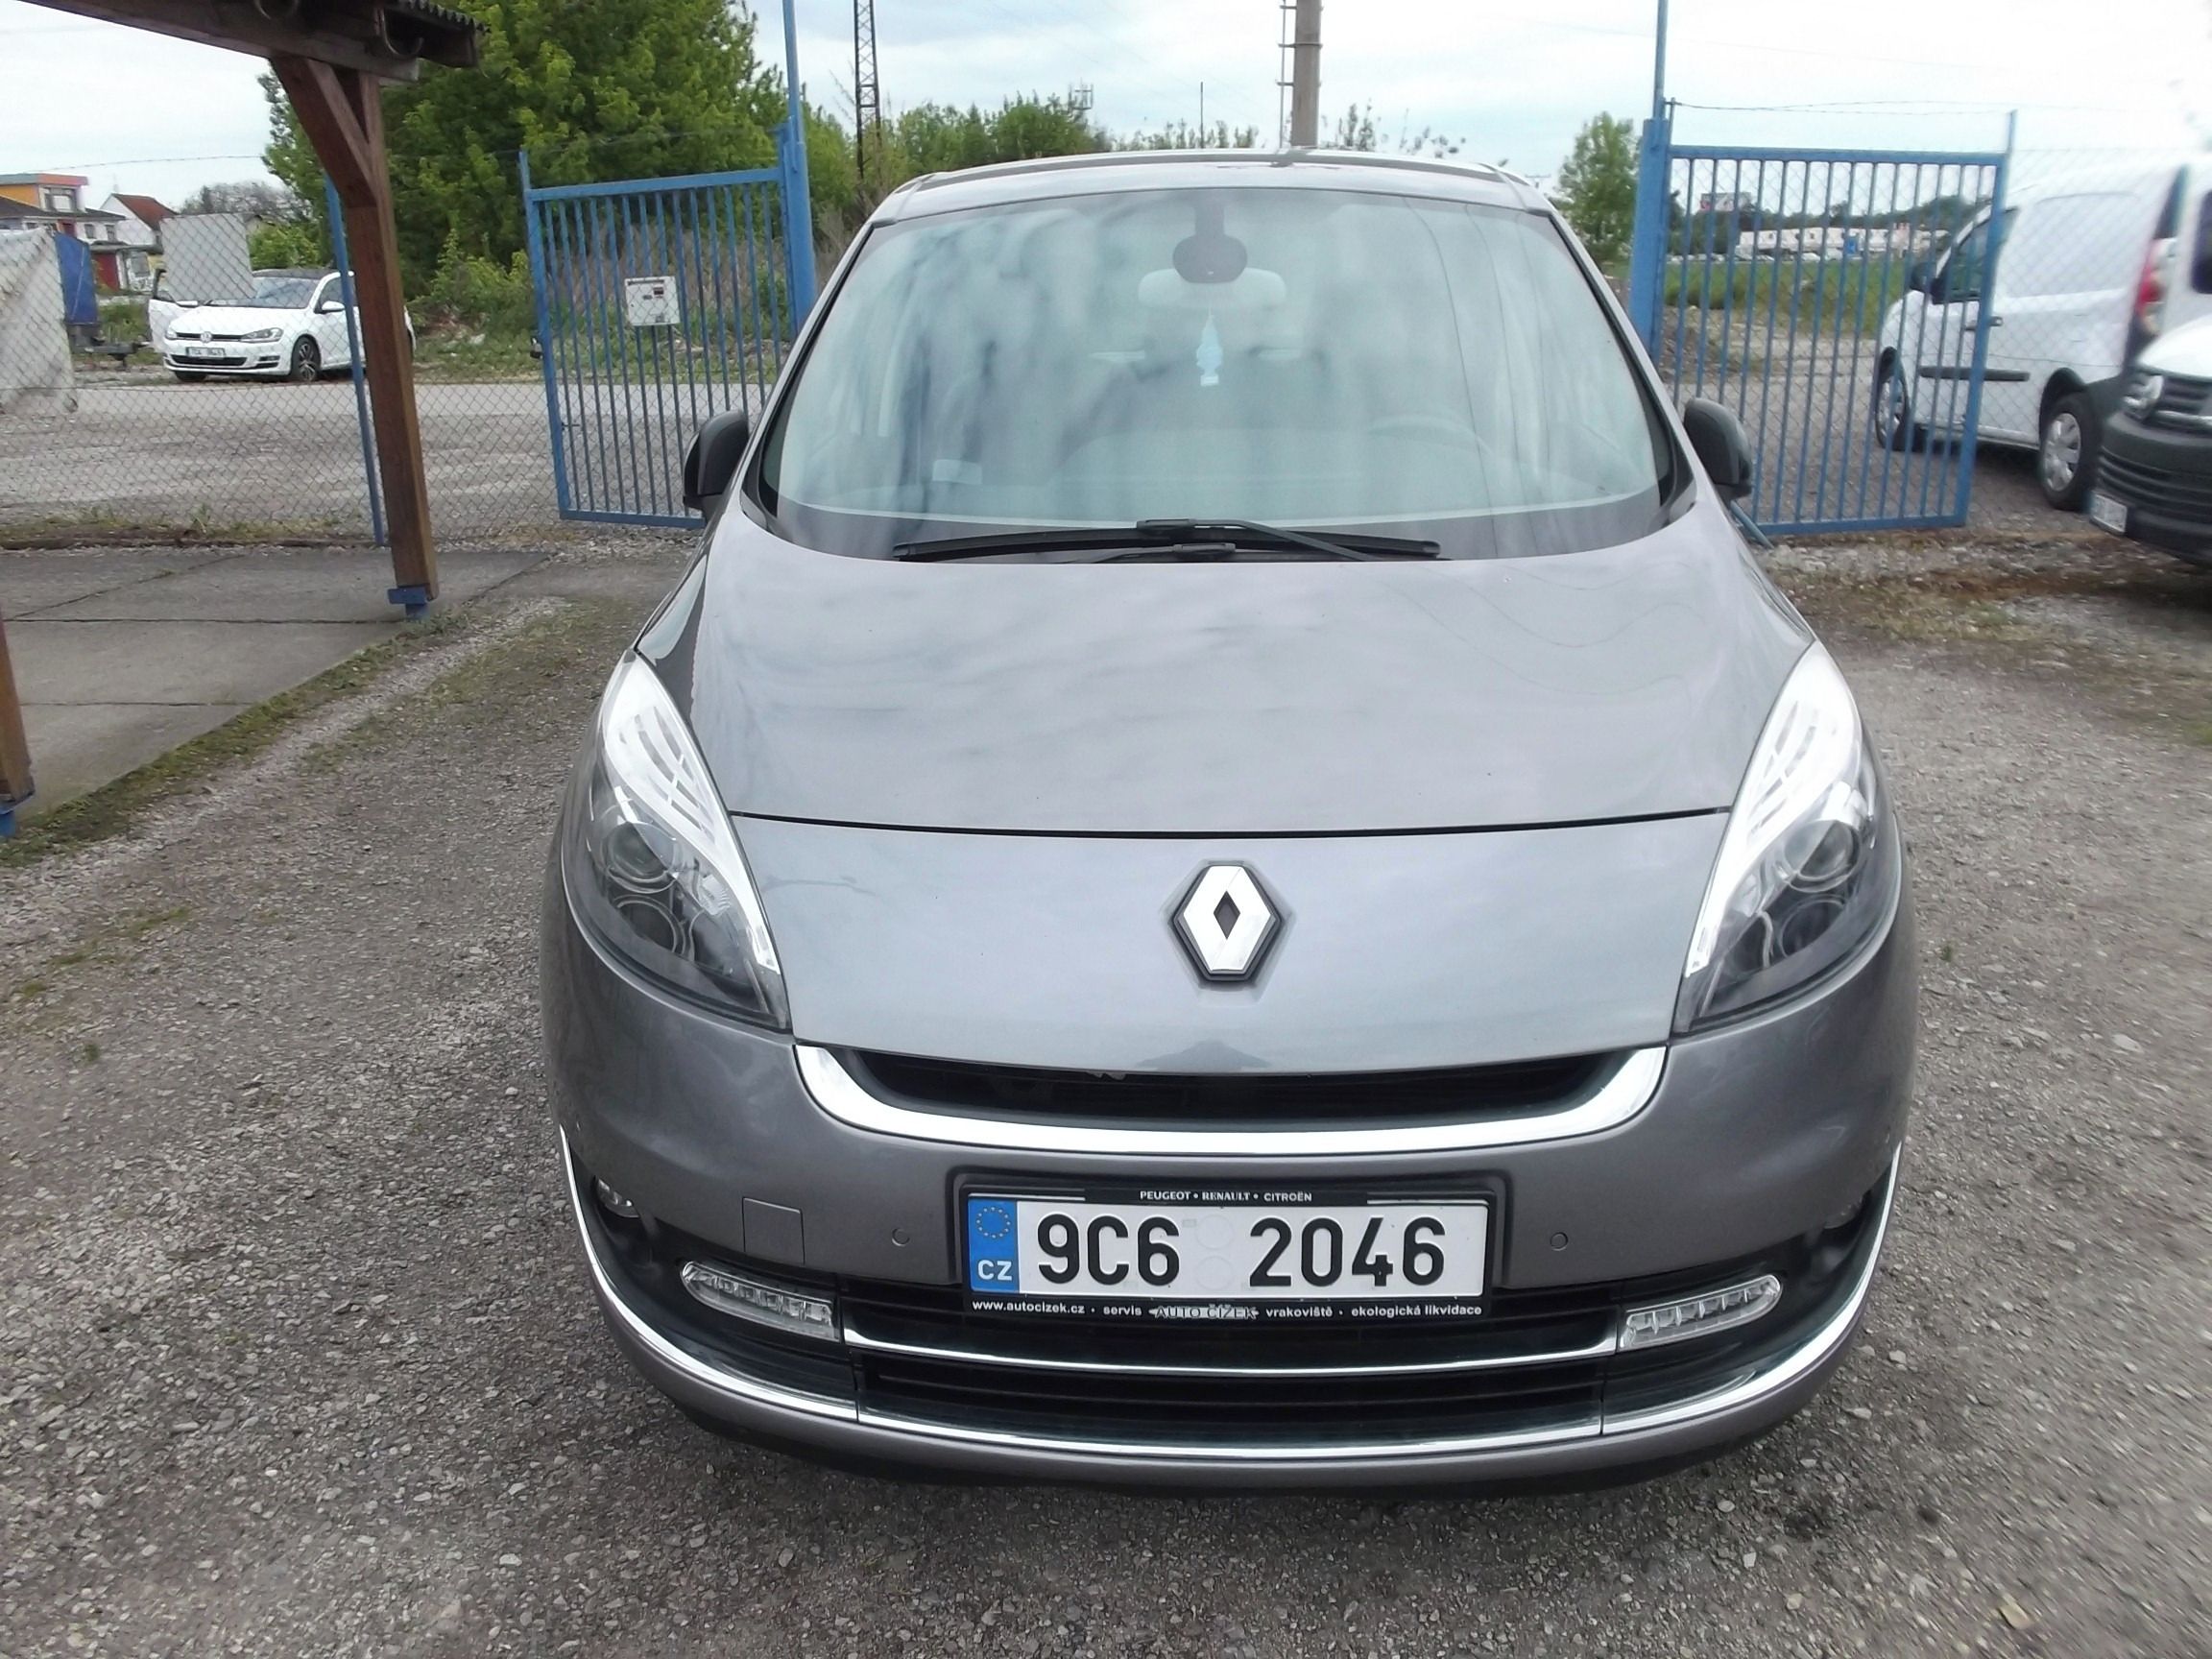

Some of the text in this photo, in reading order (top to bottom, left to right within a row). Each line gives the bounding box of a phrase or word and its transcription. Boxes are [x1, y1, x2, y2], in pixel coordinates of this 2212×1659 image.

[1140, 1190, 1312, 1202] PEUGEOT RENAULT CITROËN
[1037, 1214, 1446, 1287] 9C6 2046
[977, 1260, 1013, 1282] CZ
[972, 1300, 1086, 1315] www.autocizek.cz
[1103, 1305, 1142, 1316] servis
[1154, 1306, 1202, 1319] AUTO
[1265, 1306, 1334, 1318] vrakoviště
[1351, 1305, 1422, 1319] ekologická
[1424, 1304, 1482, 1316] likvidace
